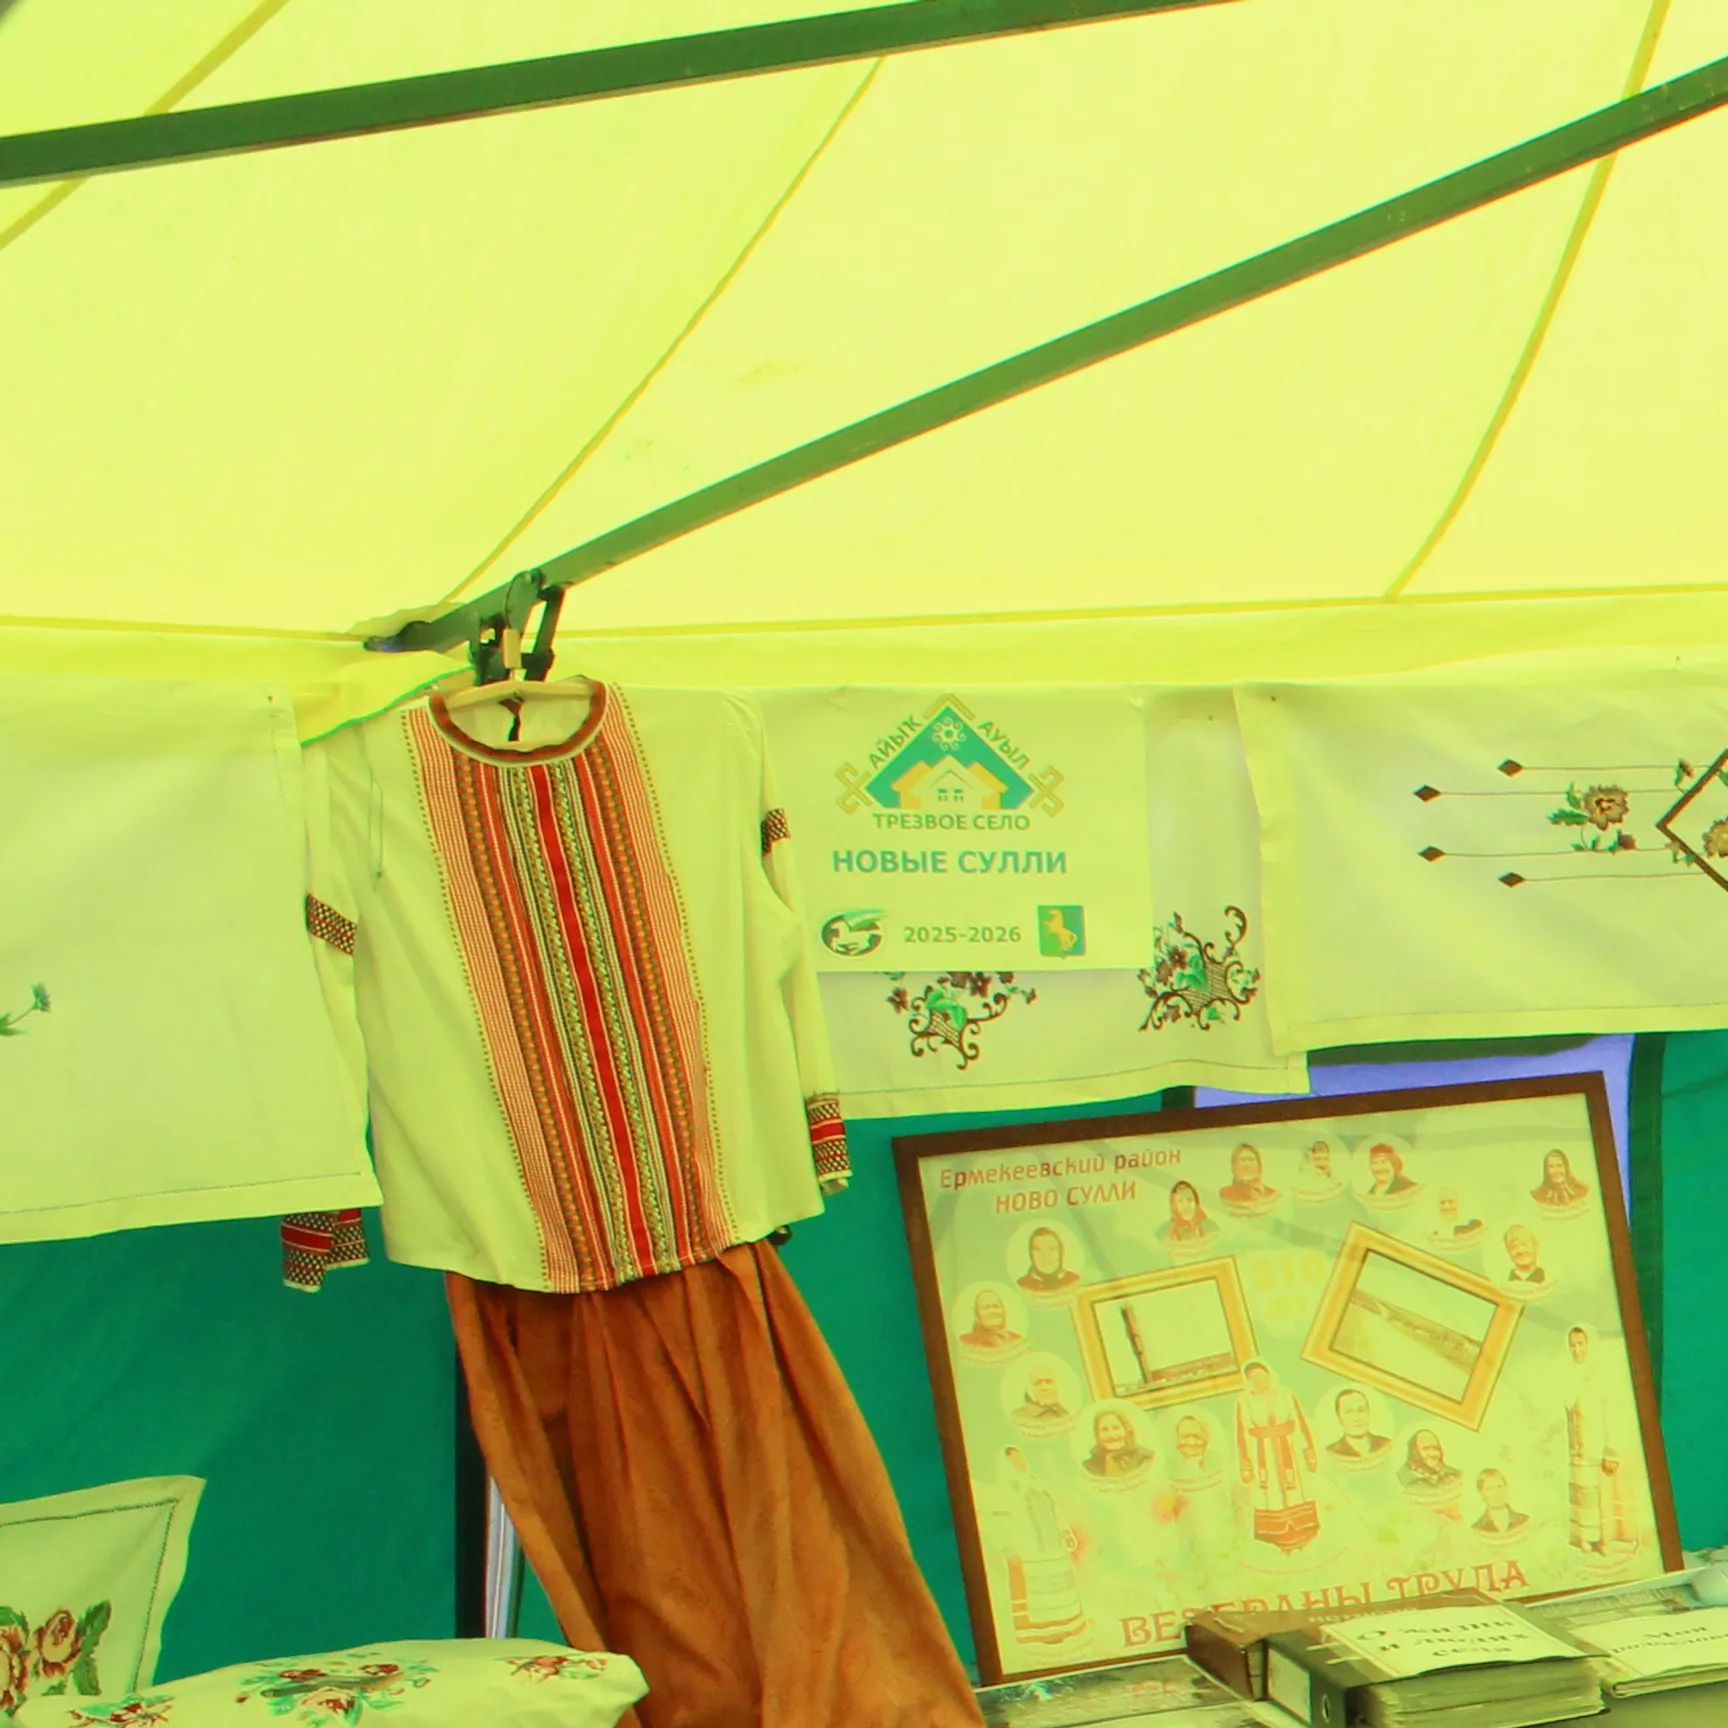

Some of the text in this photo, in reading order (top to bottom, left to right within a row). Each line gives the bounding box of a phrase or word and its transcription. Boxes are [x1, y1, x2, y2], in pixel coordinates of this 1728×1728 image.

[977, 720, 1033, 770] АУЫЛ
[872, 813, 1030, 831] ТРЕЗВОЕ СЕЛО
[832, 849, 1067, 874] НОВЫЕ СУЛЛИ
[903, 926, 1022, 943] 2025-2026
[939, 1148, 1181, 1190] Ермекеевский район
[996, 1181, 1137, 1214] НОВО СУЛЛИ
[1250, 1252, 1325, 1291] 210
[1356, 1630, 1387, 1641] О
